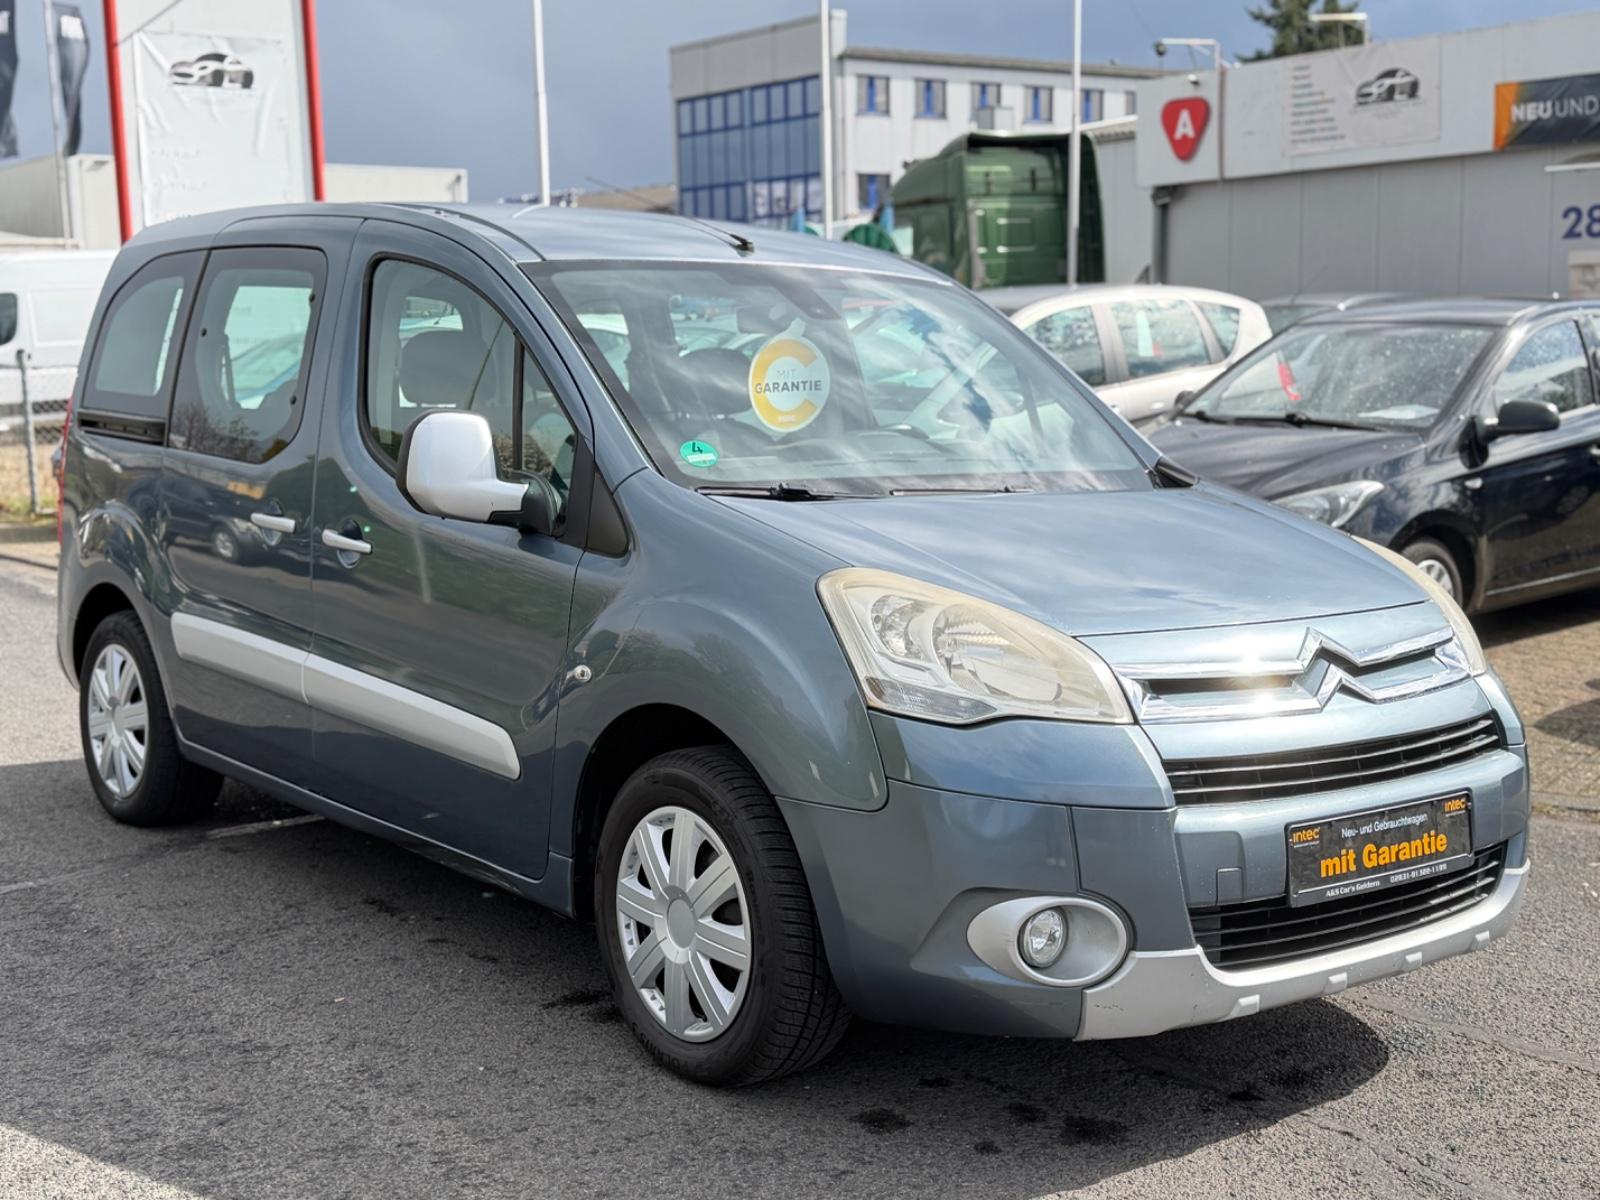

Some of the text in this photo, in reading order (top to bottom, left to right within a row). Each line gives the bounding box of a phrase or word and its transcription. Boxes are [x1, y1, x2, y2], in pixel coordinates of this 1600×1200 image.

[1511, 96, 1599, 122] NEU UND
[1174, 109, 1195, 141] A
[1562, 203, 1600, 240] 28
[755, 380, 822, 394] GARANTIE
[1341, 813, 1428, 838] Neu- und Gebrauchtwagen
[1321, 831, 1448, 878] mit Garantie
